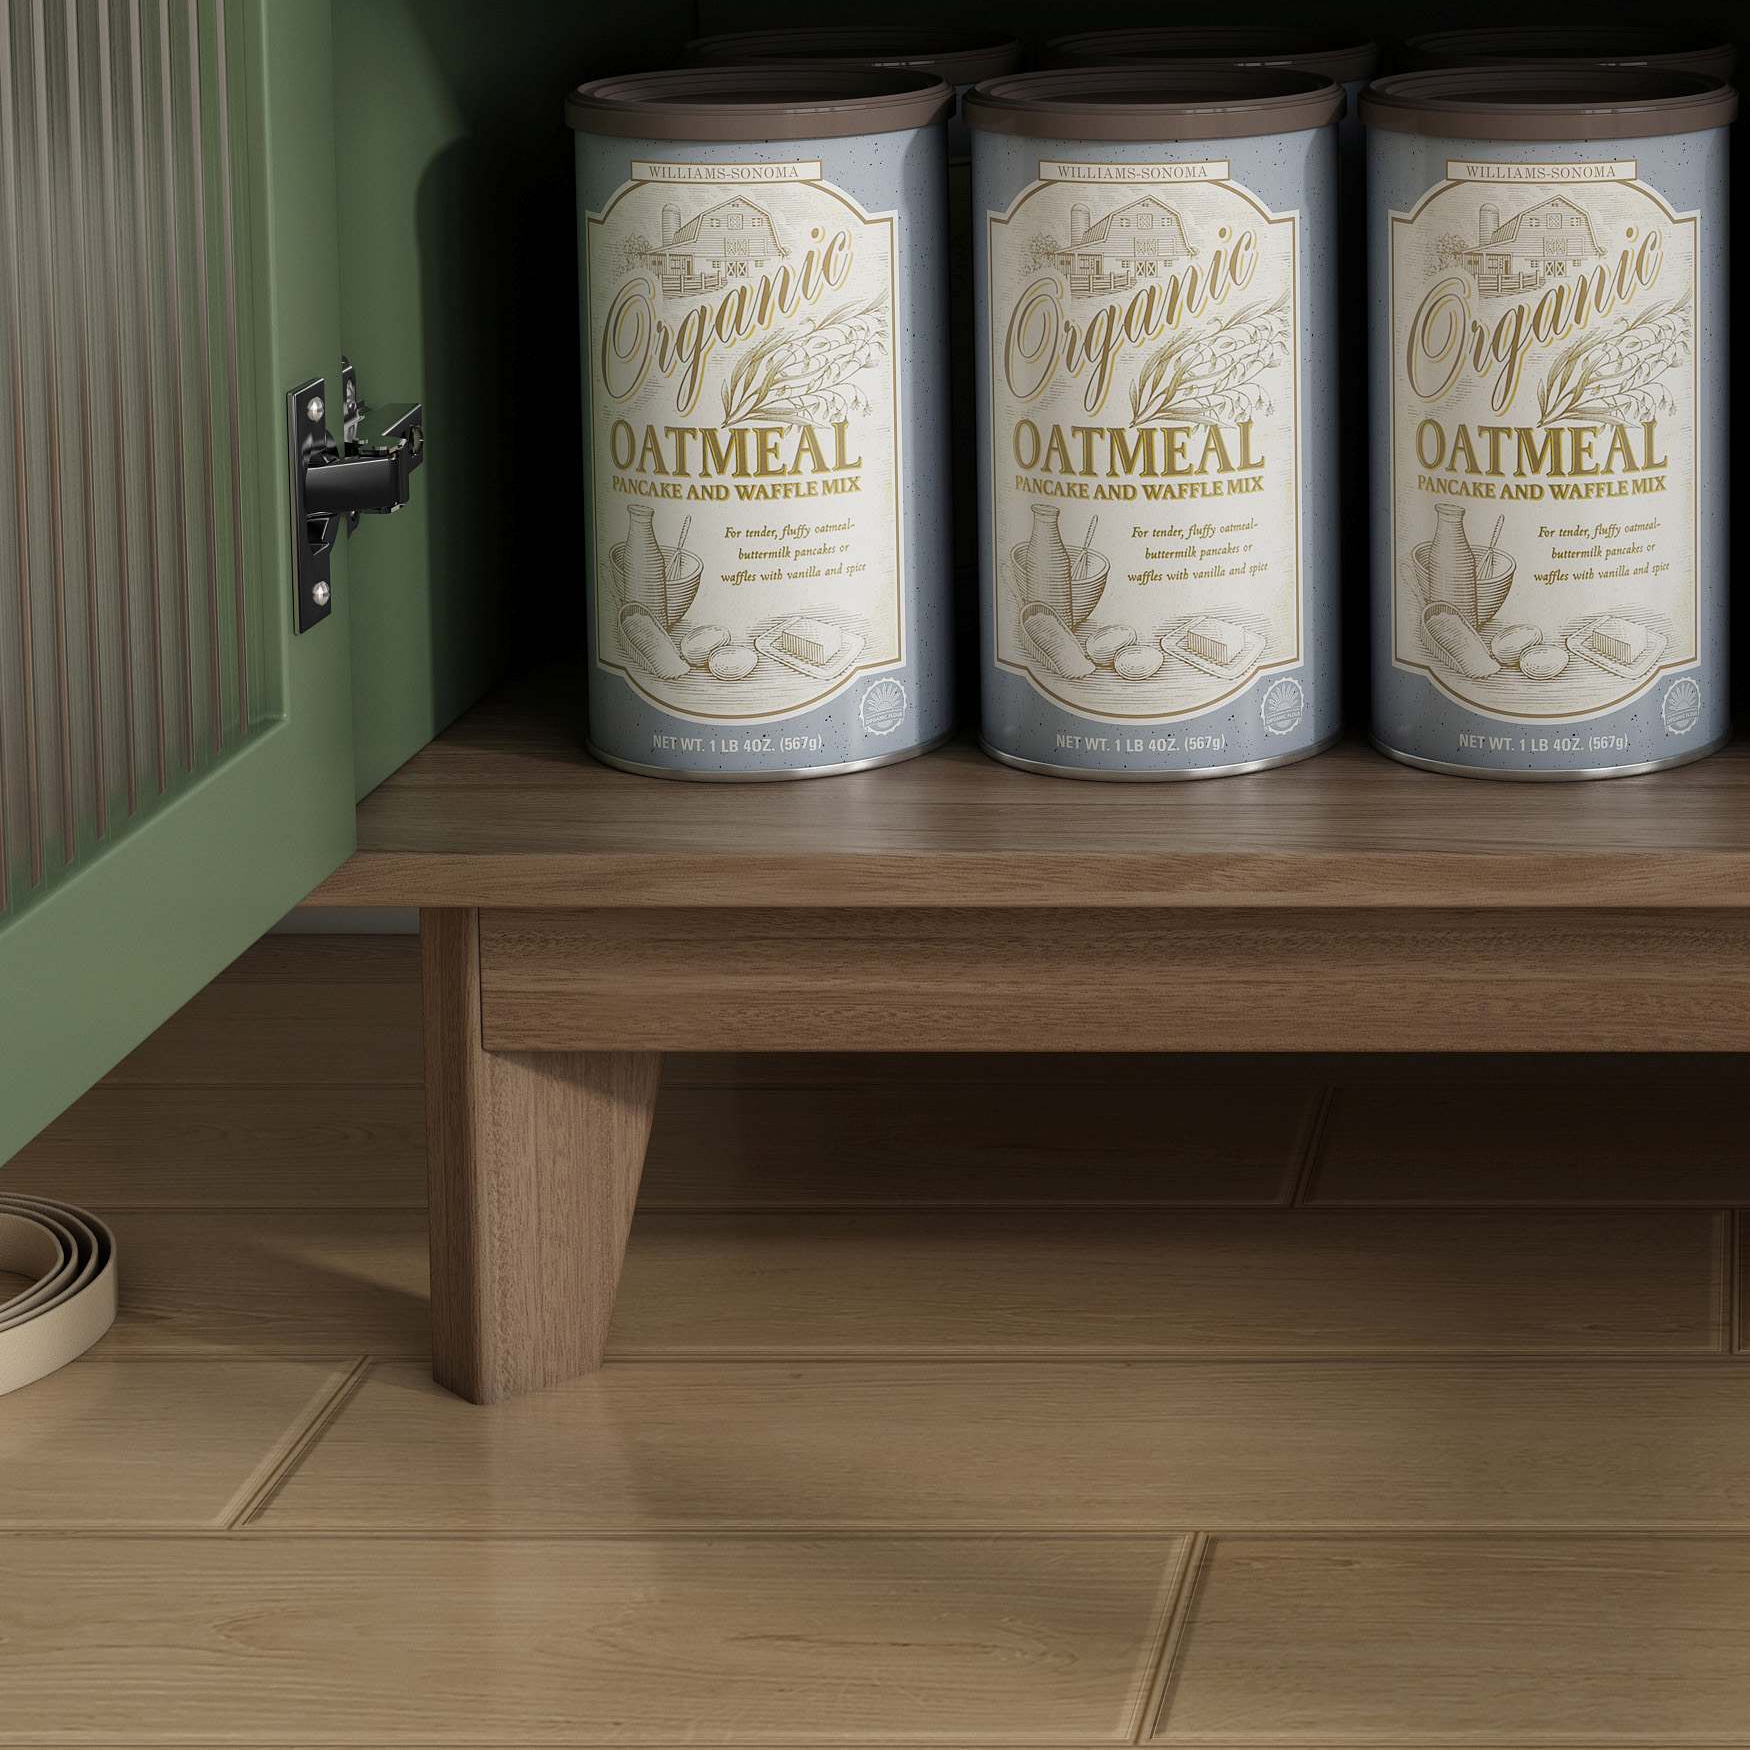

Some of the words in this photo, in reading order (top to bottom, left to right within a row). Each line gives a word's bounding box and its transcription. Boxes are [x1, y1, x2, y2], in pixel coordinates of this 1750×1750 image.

[649, 165, 799, 180] WILLIAMS-SONOMA
[1057, 165, 1207, 180] WILLIAMS-SONOMA
[1466, 165, 1616, 180] WILLIAMS-SONOMA
[603, 227, 853, 417] Organic
[1004, 227, 1259, 417] Organic
[1406, 227, 1663, 417] Organic
[609, 418, 863, 478] OATMEAL
[1013, 418, 1267, 478] OATMEAL
[1415, 418, 1668, 478] OATMEAL
[612, 475, 682, 499] PANCAKE
[686, 484, 729, 500] AND
[734, 481, 819, 500] WAFFLE
[821, 475, 863, 495] MIX
[1015, 475, 1089, 499] PANCAKE
[1093, 484, 1137, 500] AND
[1142, 481, 1224, 500] WAFFLE
[1226, 475, 1266, 495] MIX
[1418, 475, 1496, 499] PANCAKE
[1500, 484, 1543, 500] AND
[1549, 481, 1630, 500] WAFFLE
[1631, 475, 1669, 495] MIX
[724, 526, 741, 539] For
[746, 527, 777, 540] tender,
[780, 525, 811, 540] fluffy
[814, 517, 856, 533] oatmeal-
[738, 546, 791, 560] buttermilk
[794, 544, 836, 559] pancakes
[839, 543, 850, 553] or
[720, 570, 756, 586] waffles
[760, 568, 782, 581] with
[787, 567, 821, 580] vanilla
[825, 563, 842, 576] and
[845, 561, 866, 577] spice
[653, 734, 676, 750] NET
[681, 737, 705, 751] WT.
[709, 740, 715, 752] 1
[721, 740, 738, 752] LB
[780, 734, 823, 752] (567g)
[1458, 734, 1485, 750] NET
[1488, 737, 1516, 751] WT.
[1518, 740, 1525, 752] 1
[1530, 740, 1548, 752] LB
[1588, 734, 1630, 752] (567g)
